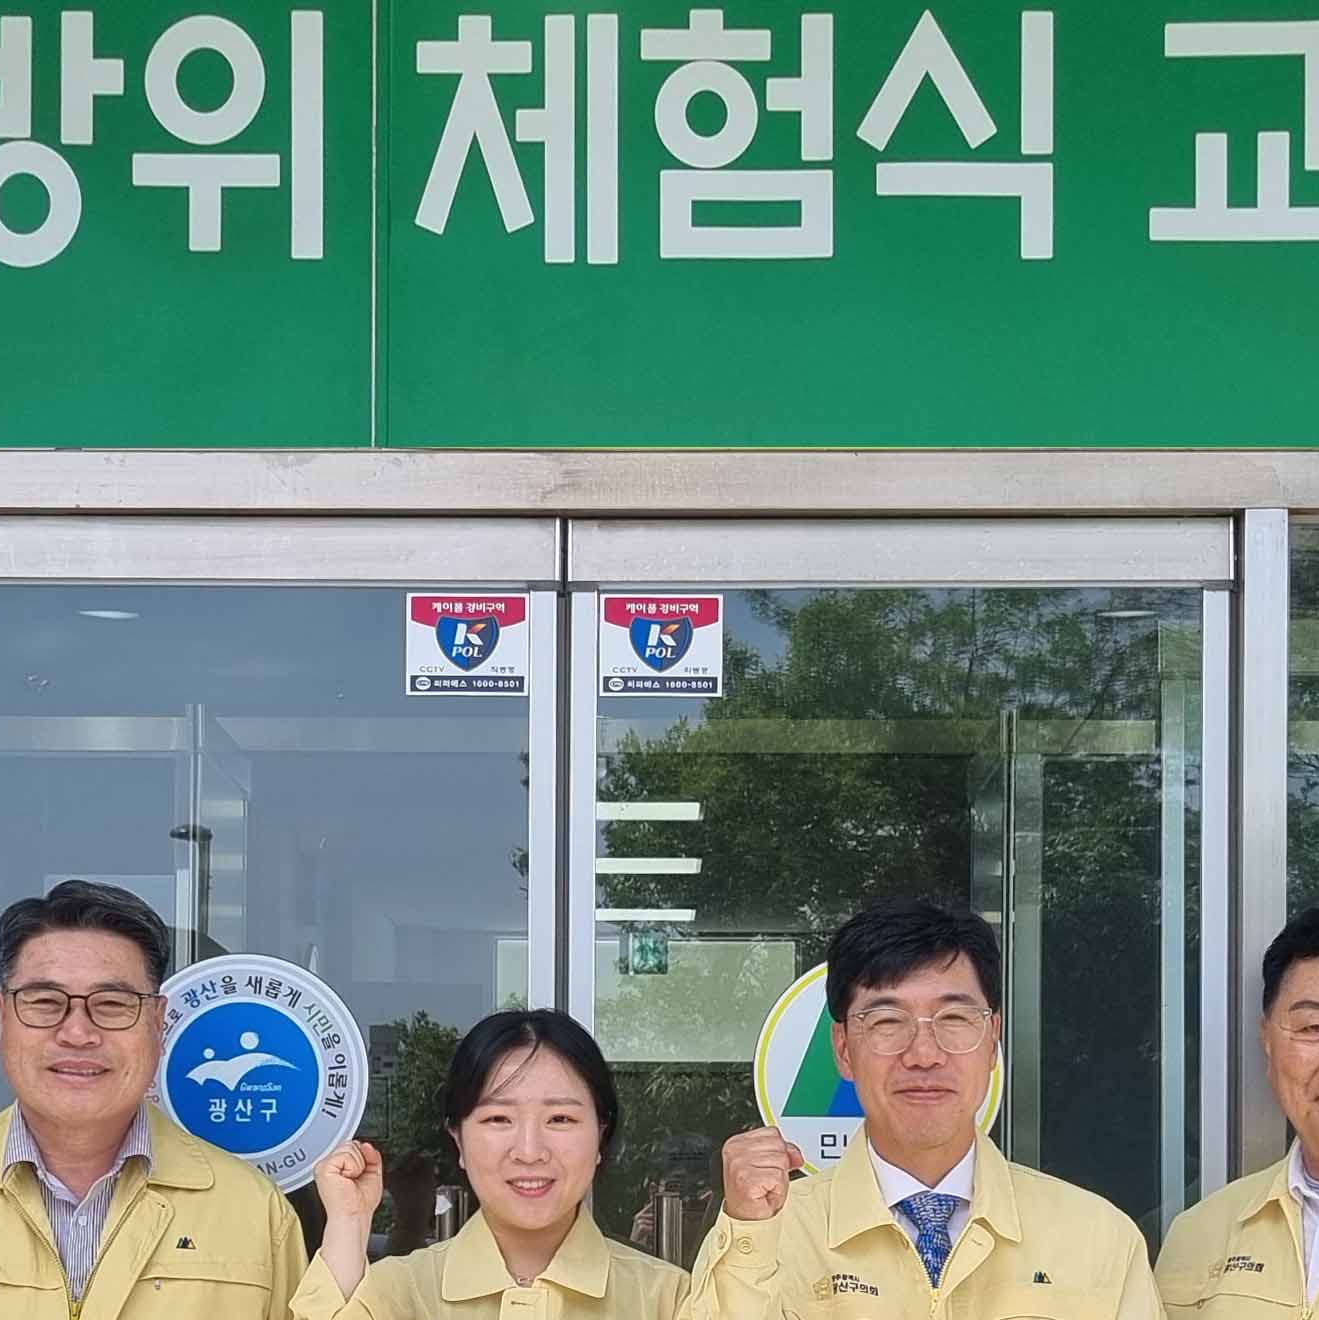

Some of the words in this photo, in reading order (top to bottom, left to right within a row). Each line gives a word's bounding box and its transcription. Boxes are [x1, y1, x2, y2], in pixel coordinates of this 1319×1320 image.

[414, 8, 1055, 264] 체험식
[465, 602, 505, 614] 경비구역
[658, 603, 699, 614] 경비구역
[454, 623, 487, 646] K
[648, 624, 681, 647] K
[451, 646, 483, 658] POL
[645, 647, 676, 659] POL
[419, 665, 445, 673] CCTV
[612, 666, 638, 674] CCTV
[179, 975, 238, 1009] 광산을
[244, 975, 303, 1009] 새롭게
[303, 1003, 342, 1051] 시민을
[208, 1098, 279, 1122] 광산구
